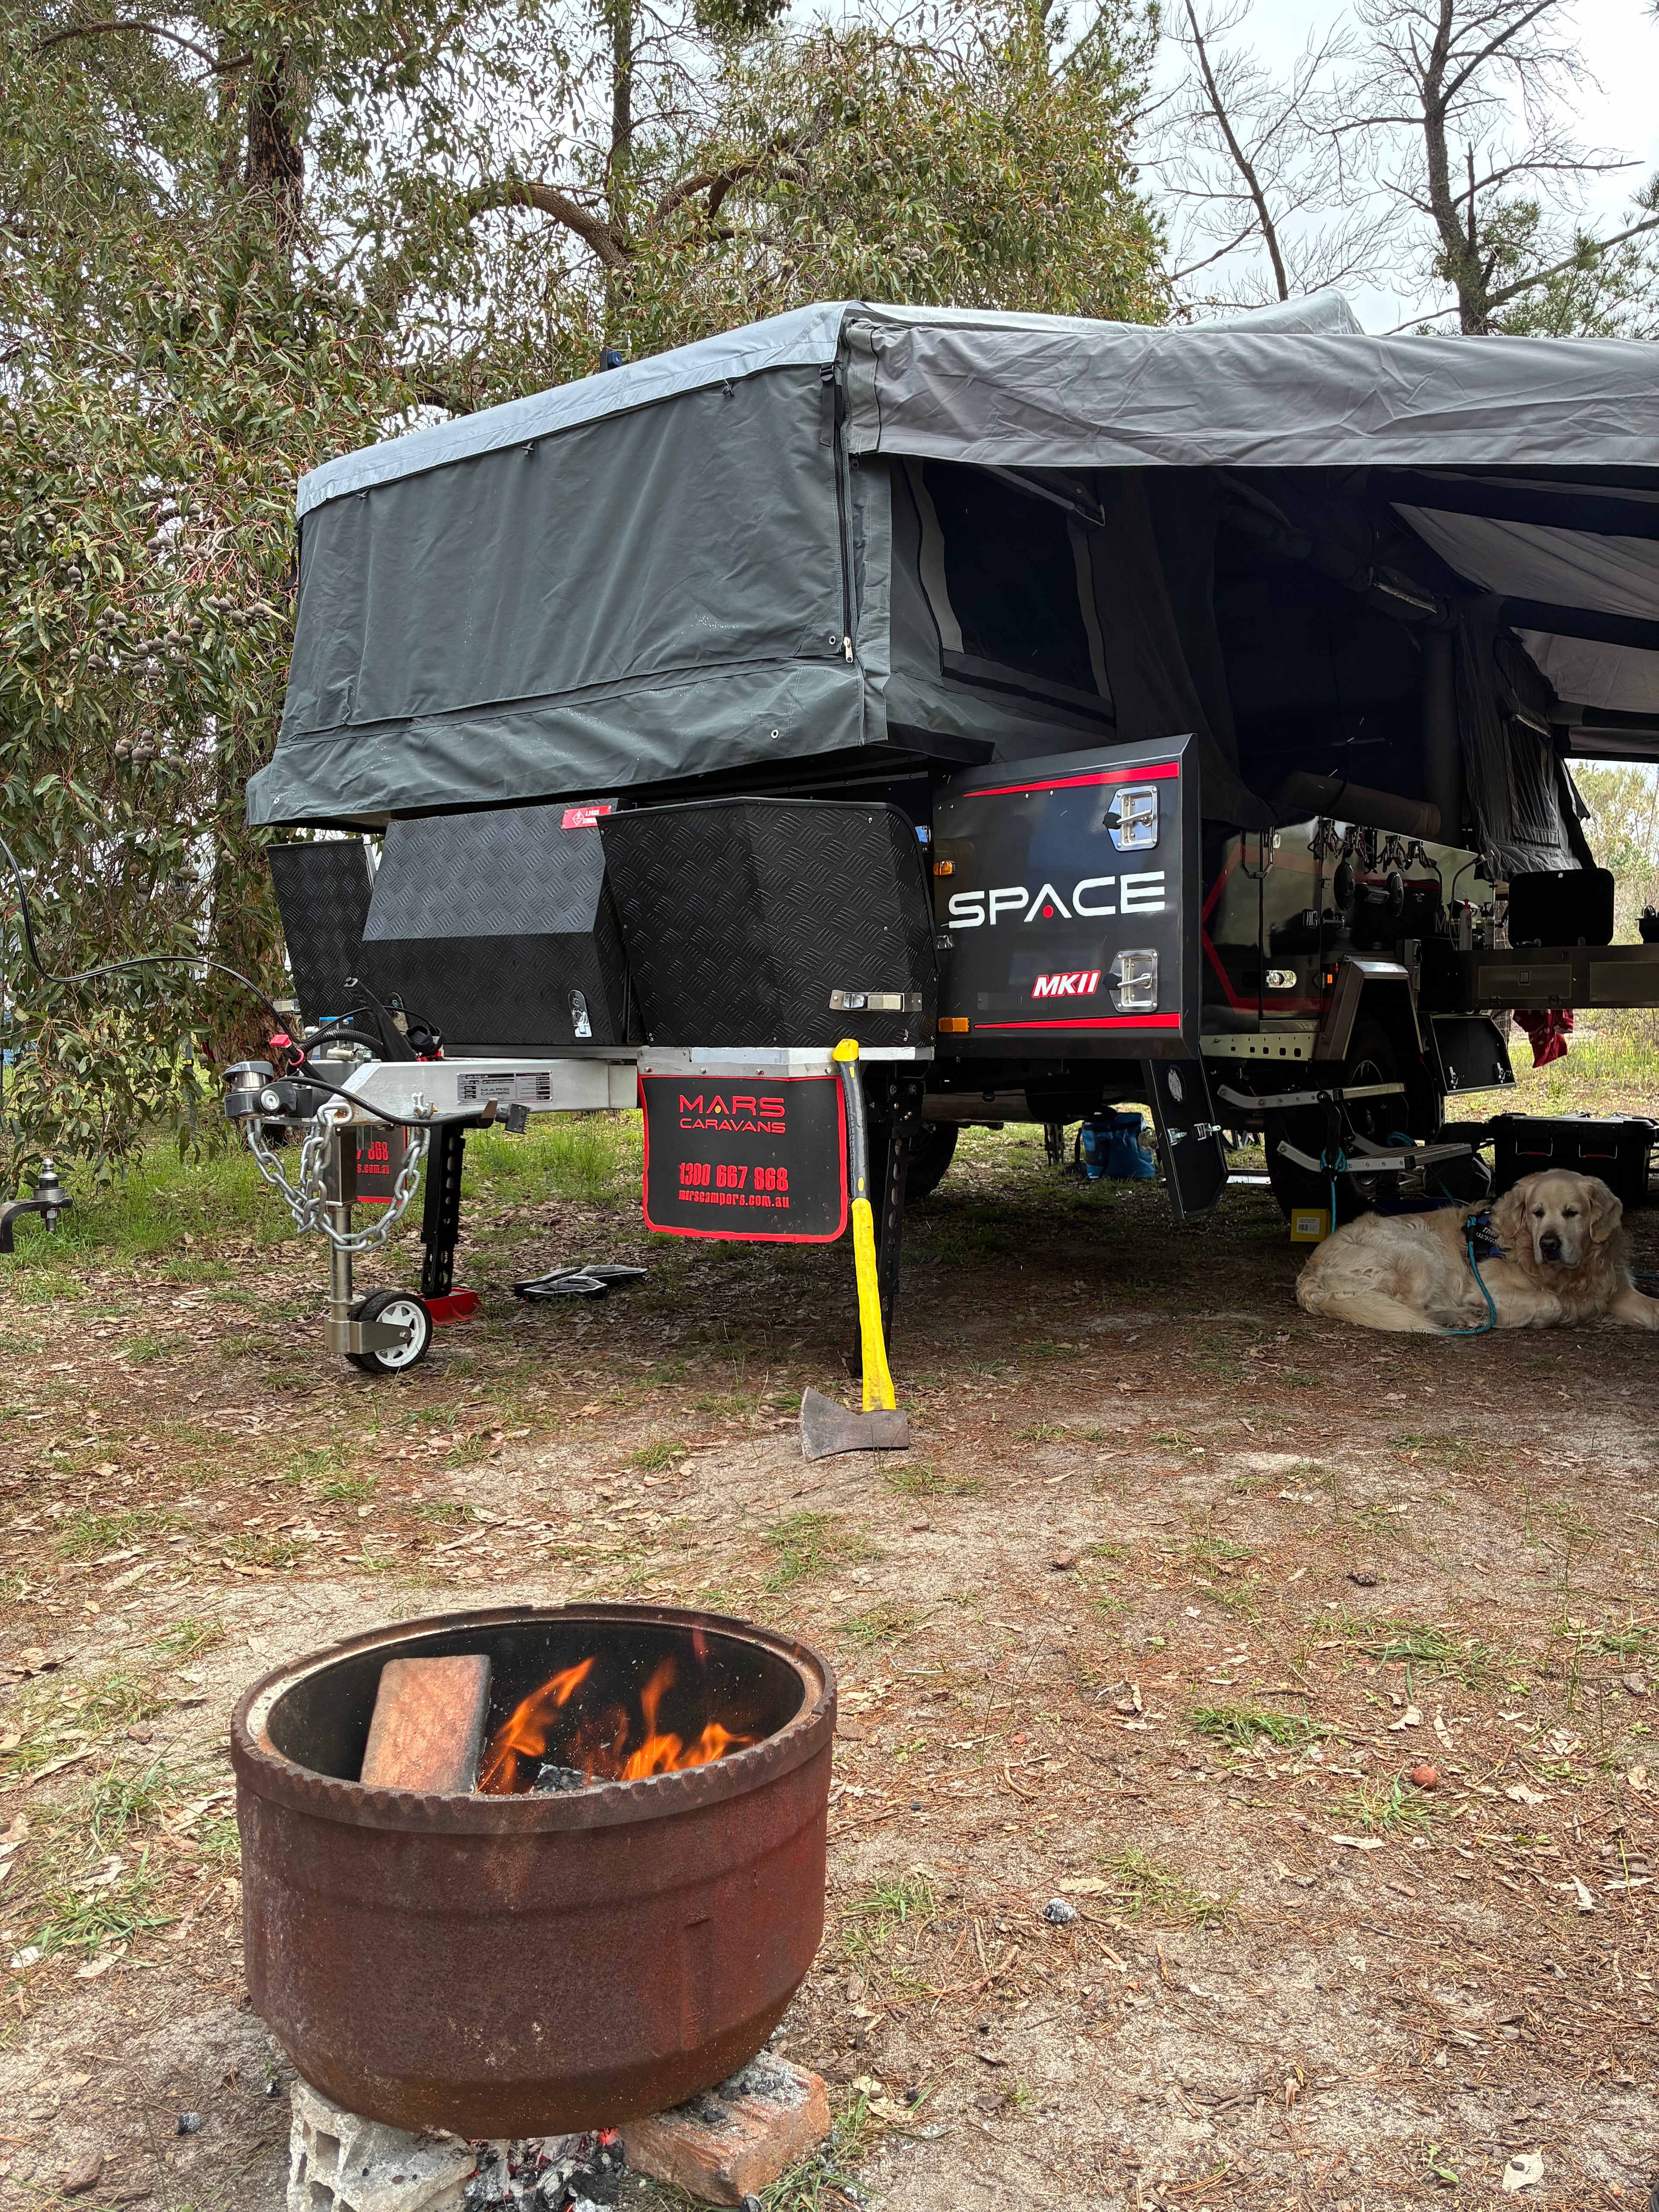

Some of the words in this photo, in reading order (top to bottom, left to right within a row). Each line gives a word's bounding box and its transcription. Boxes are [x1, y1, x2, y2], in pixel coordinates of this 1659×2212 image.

[948, 871, 1165, 928] SPACE
[1032, 972, 1100, 998] MKII
[679, 1095, 785, 1117] MARS
[680, 1118, 785, 1134] CARAVANS
[679, 1163, 711, 1186] 1300
[716, 1165, 748, 1189] 667
[754, 1167, 788, 1192] 868
[678, 1190, 790, 1208] marscampers.com.au
